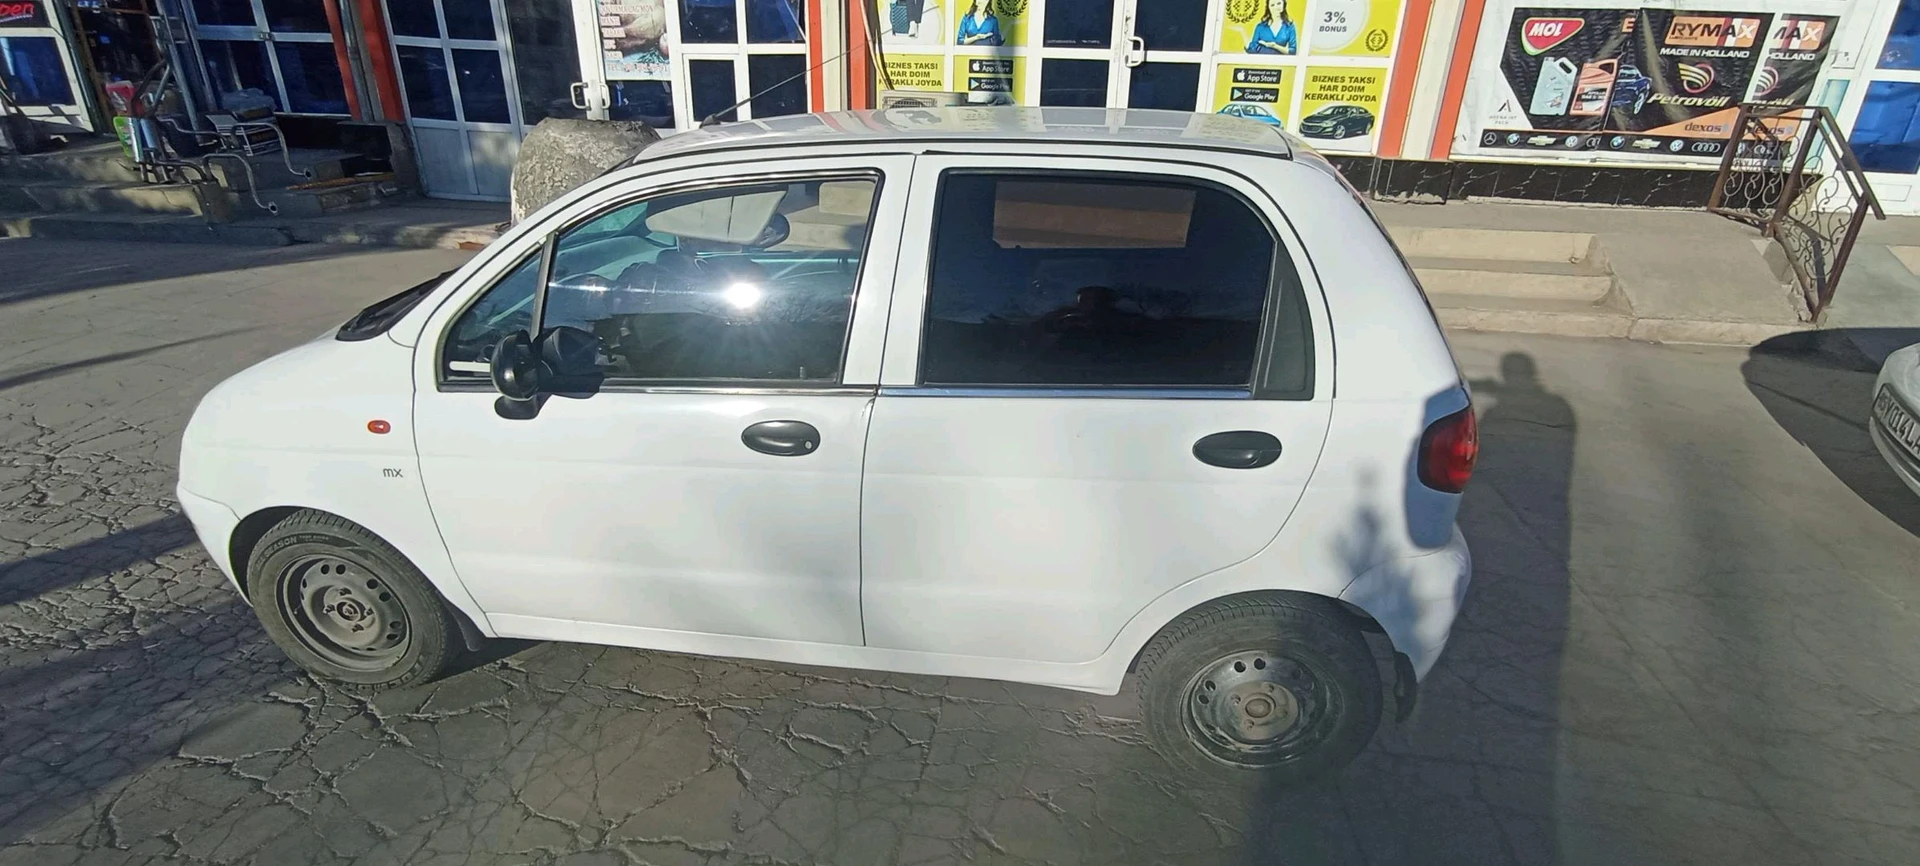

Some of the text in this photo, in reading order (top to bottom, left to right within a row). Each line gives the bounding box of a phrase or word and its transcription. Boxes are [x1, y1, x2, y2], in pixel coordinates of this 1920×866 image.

[1323, 11, 1347, 24] 3%
[1319, 25, 1347, 33] BONUS
[1528, 22, 1564, 37] MOL
[1671, 22, 1757, 39] RYMAX
[1660, 48, 1751, 59] MADE IN HOLLAND
[982, 65, 994, 73] App
[890, 70, 907, 78] HAR
[915, 79, 943, 87] JOYDA
[1247, 75, 1278, 83] App Store
[1312, 75, 1376, 84] BIZNES TAKSI
[1319, 84, 1365, 93] HAR DOIM
[1244, 93, 1276, 102] Google Play
[1304, 93, 1377, 102] KERAKLI JOYDA
[1684, 122, 1722, 132] dexos
